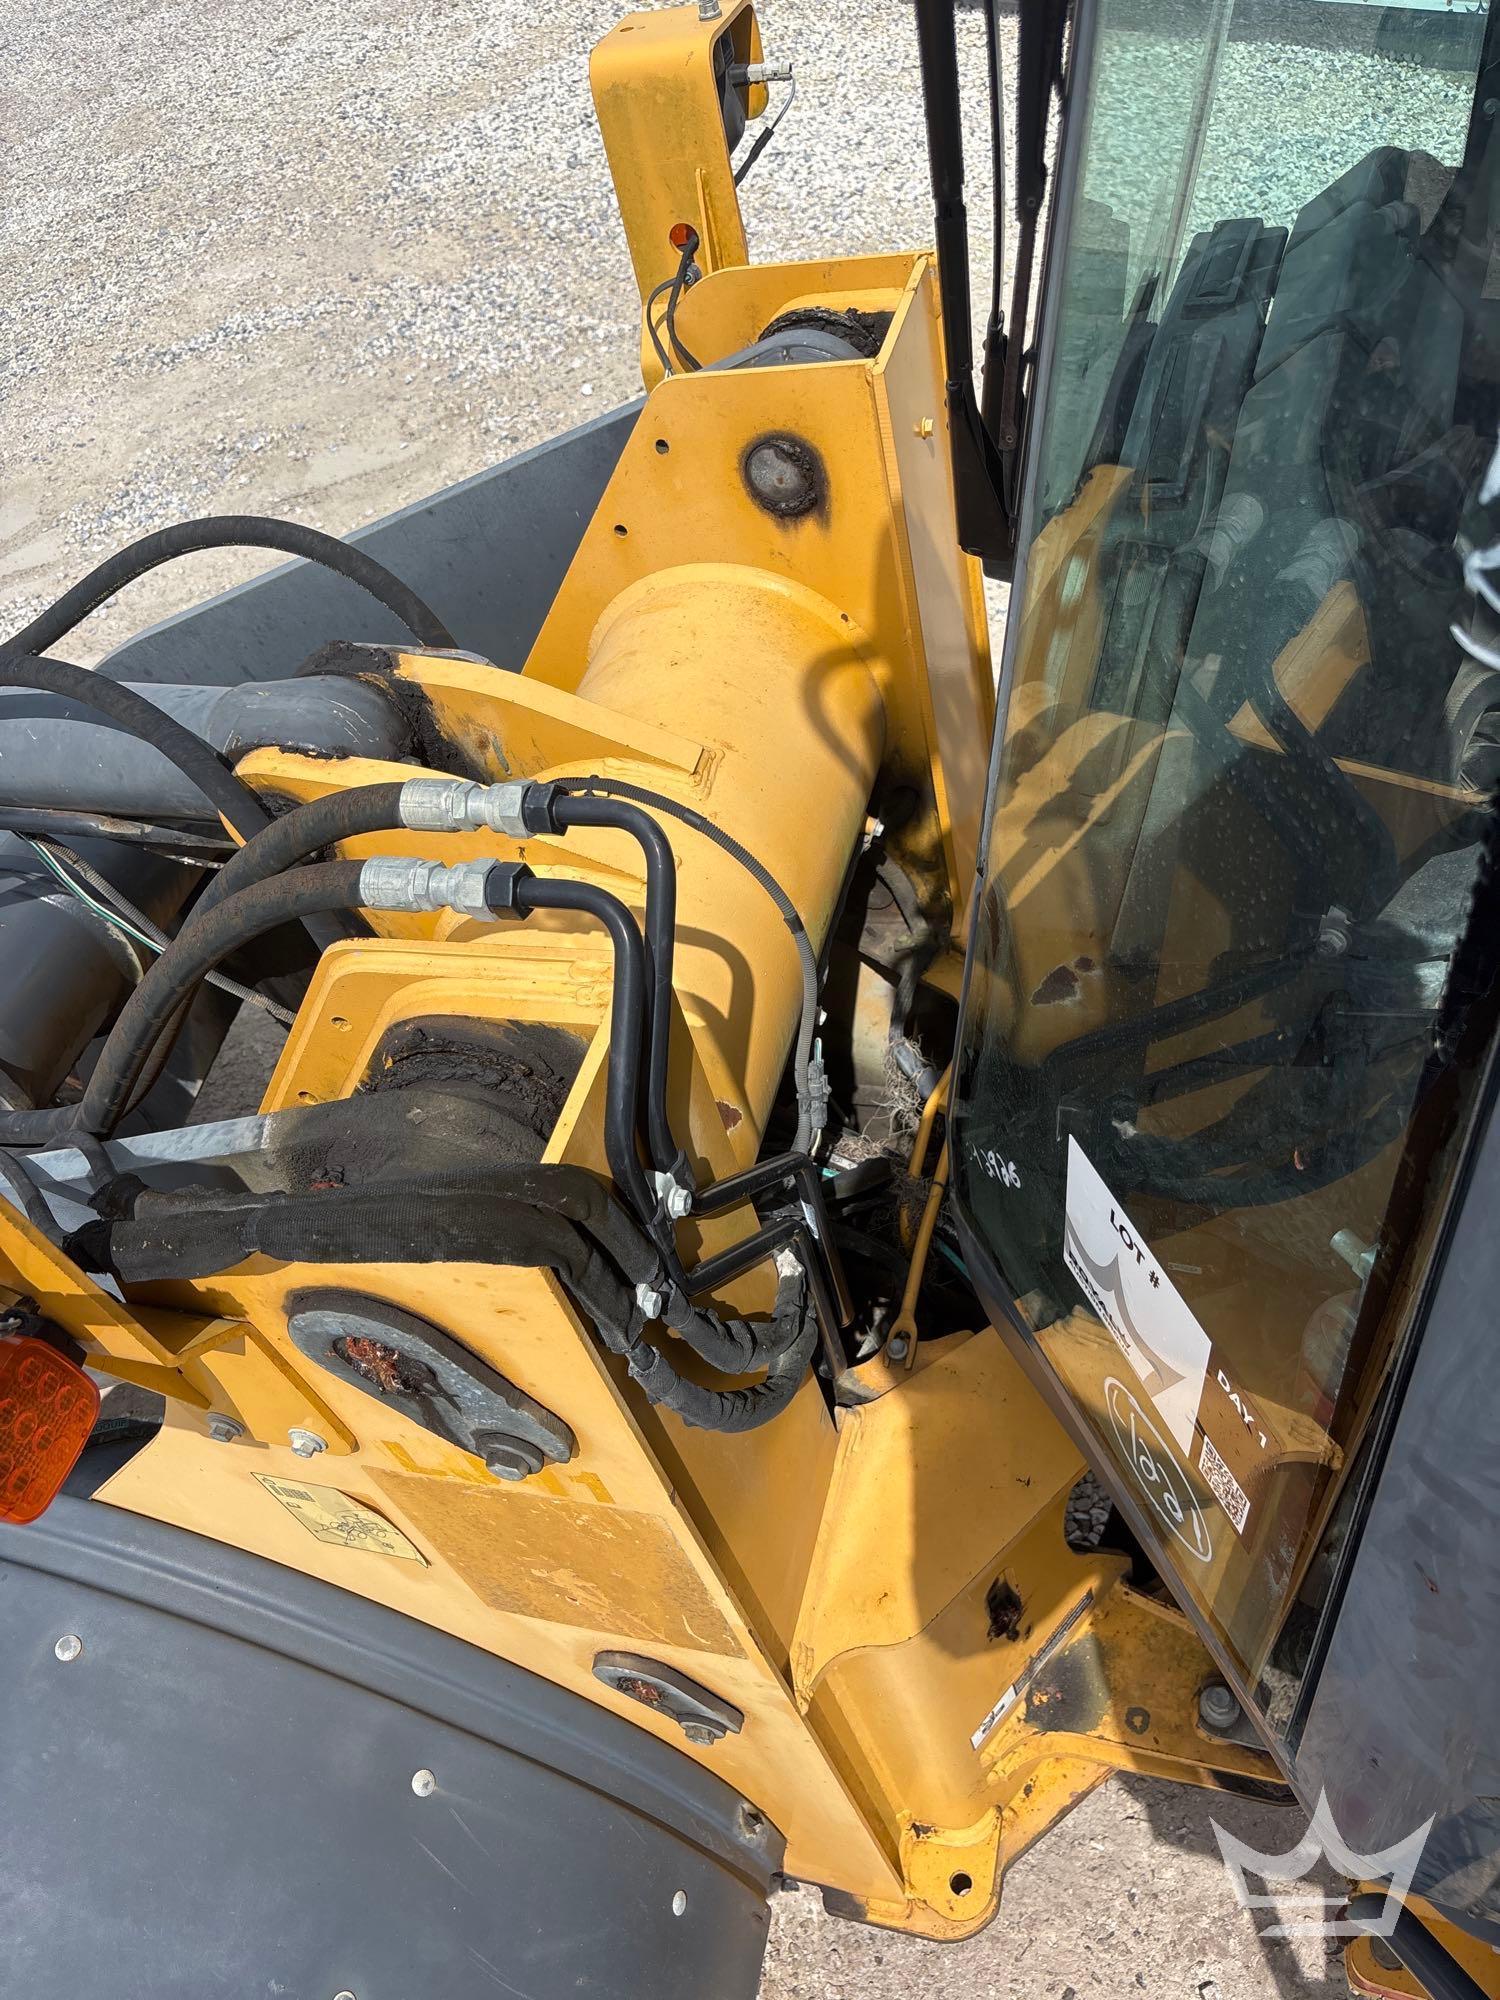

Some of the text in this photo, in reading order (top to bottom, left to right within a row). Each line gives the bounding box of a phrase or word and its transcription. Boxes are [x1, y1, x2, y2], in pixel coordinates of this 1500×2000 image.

[1110, 1209, 1161, 1289] LOT #
[1218, 1369, 1268, 1449] DAY 1
